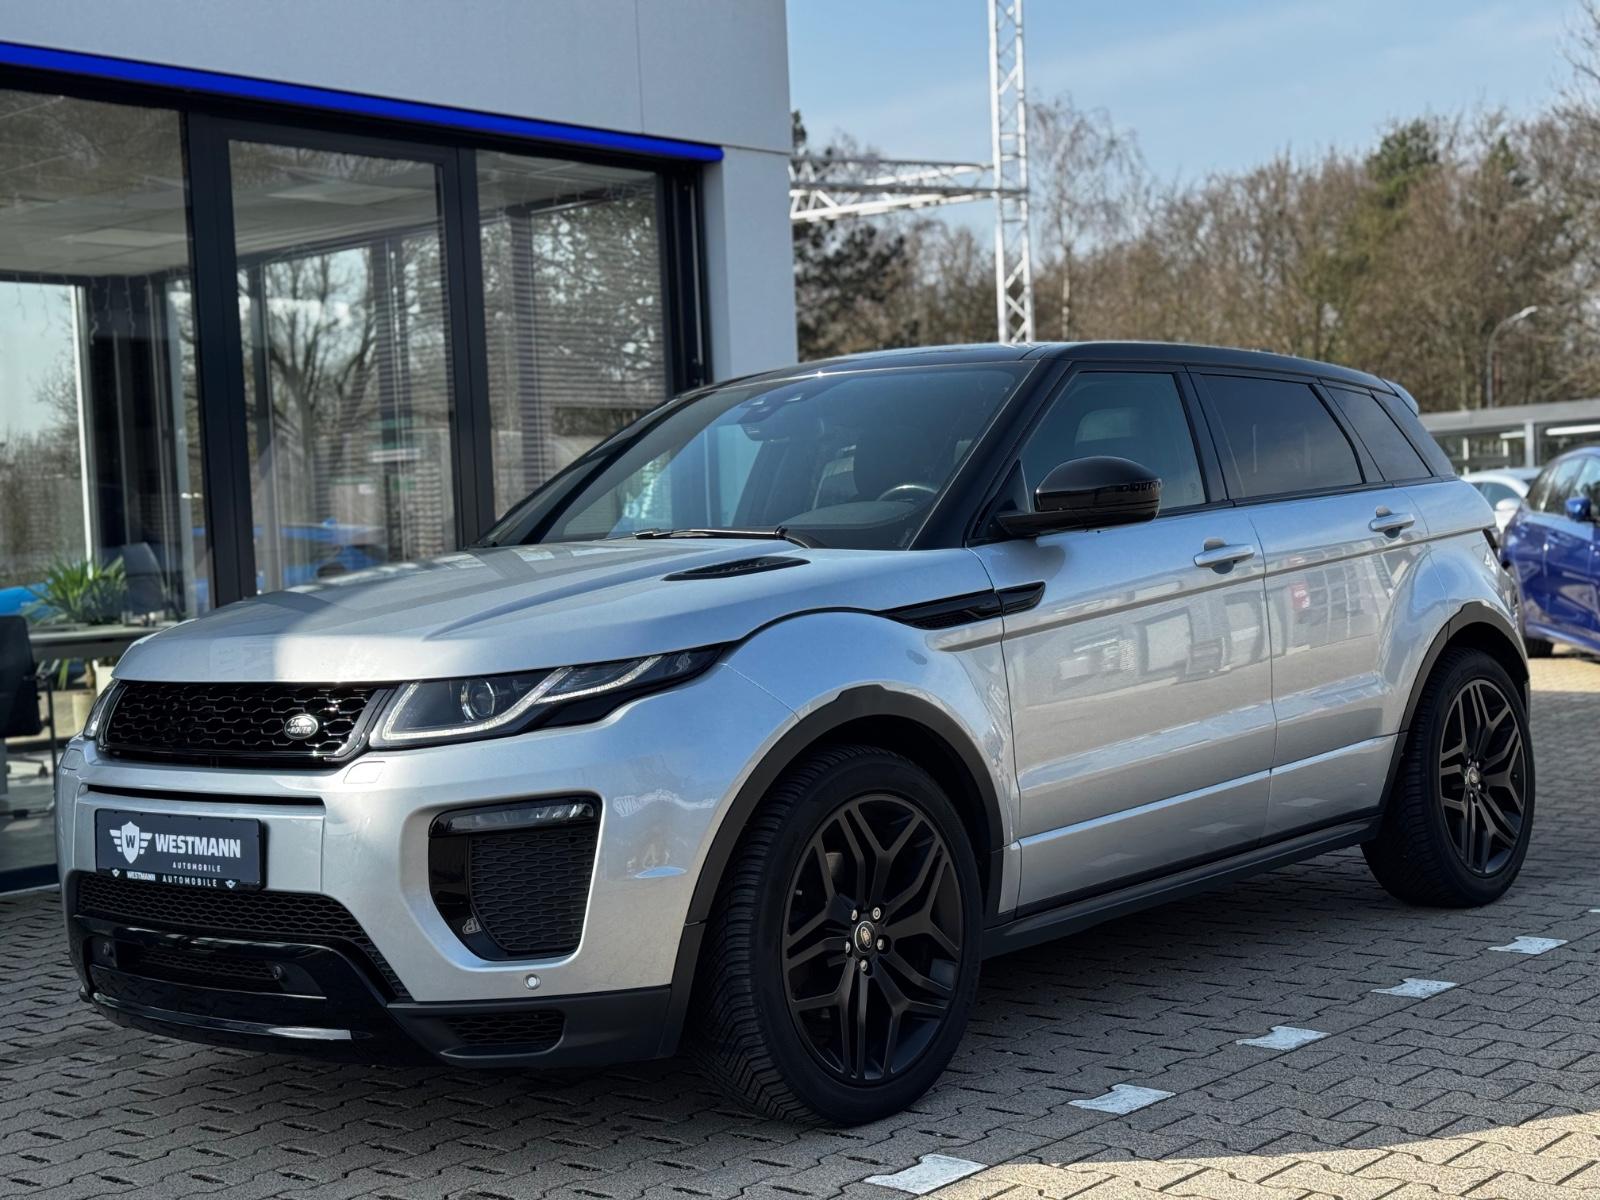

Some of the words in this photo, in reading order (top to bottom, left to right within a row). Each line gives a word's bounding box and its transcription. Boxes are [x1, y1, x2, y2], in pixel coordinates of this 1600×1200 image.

[290, 726, 312, 734] ROVER
[125, 835, 136, 848] W
[155, 833, 241, 858] WESTMANN
[172, 861, 221, 873] AUTOMOBILE
[126, 871, 156, 881] WESTMANN
[162, 875, 217, 887] AUTOMOBILE
